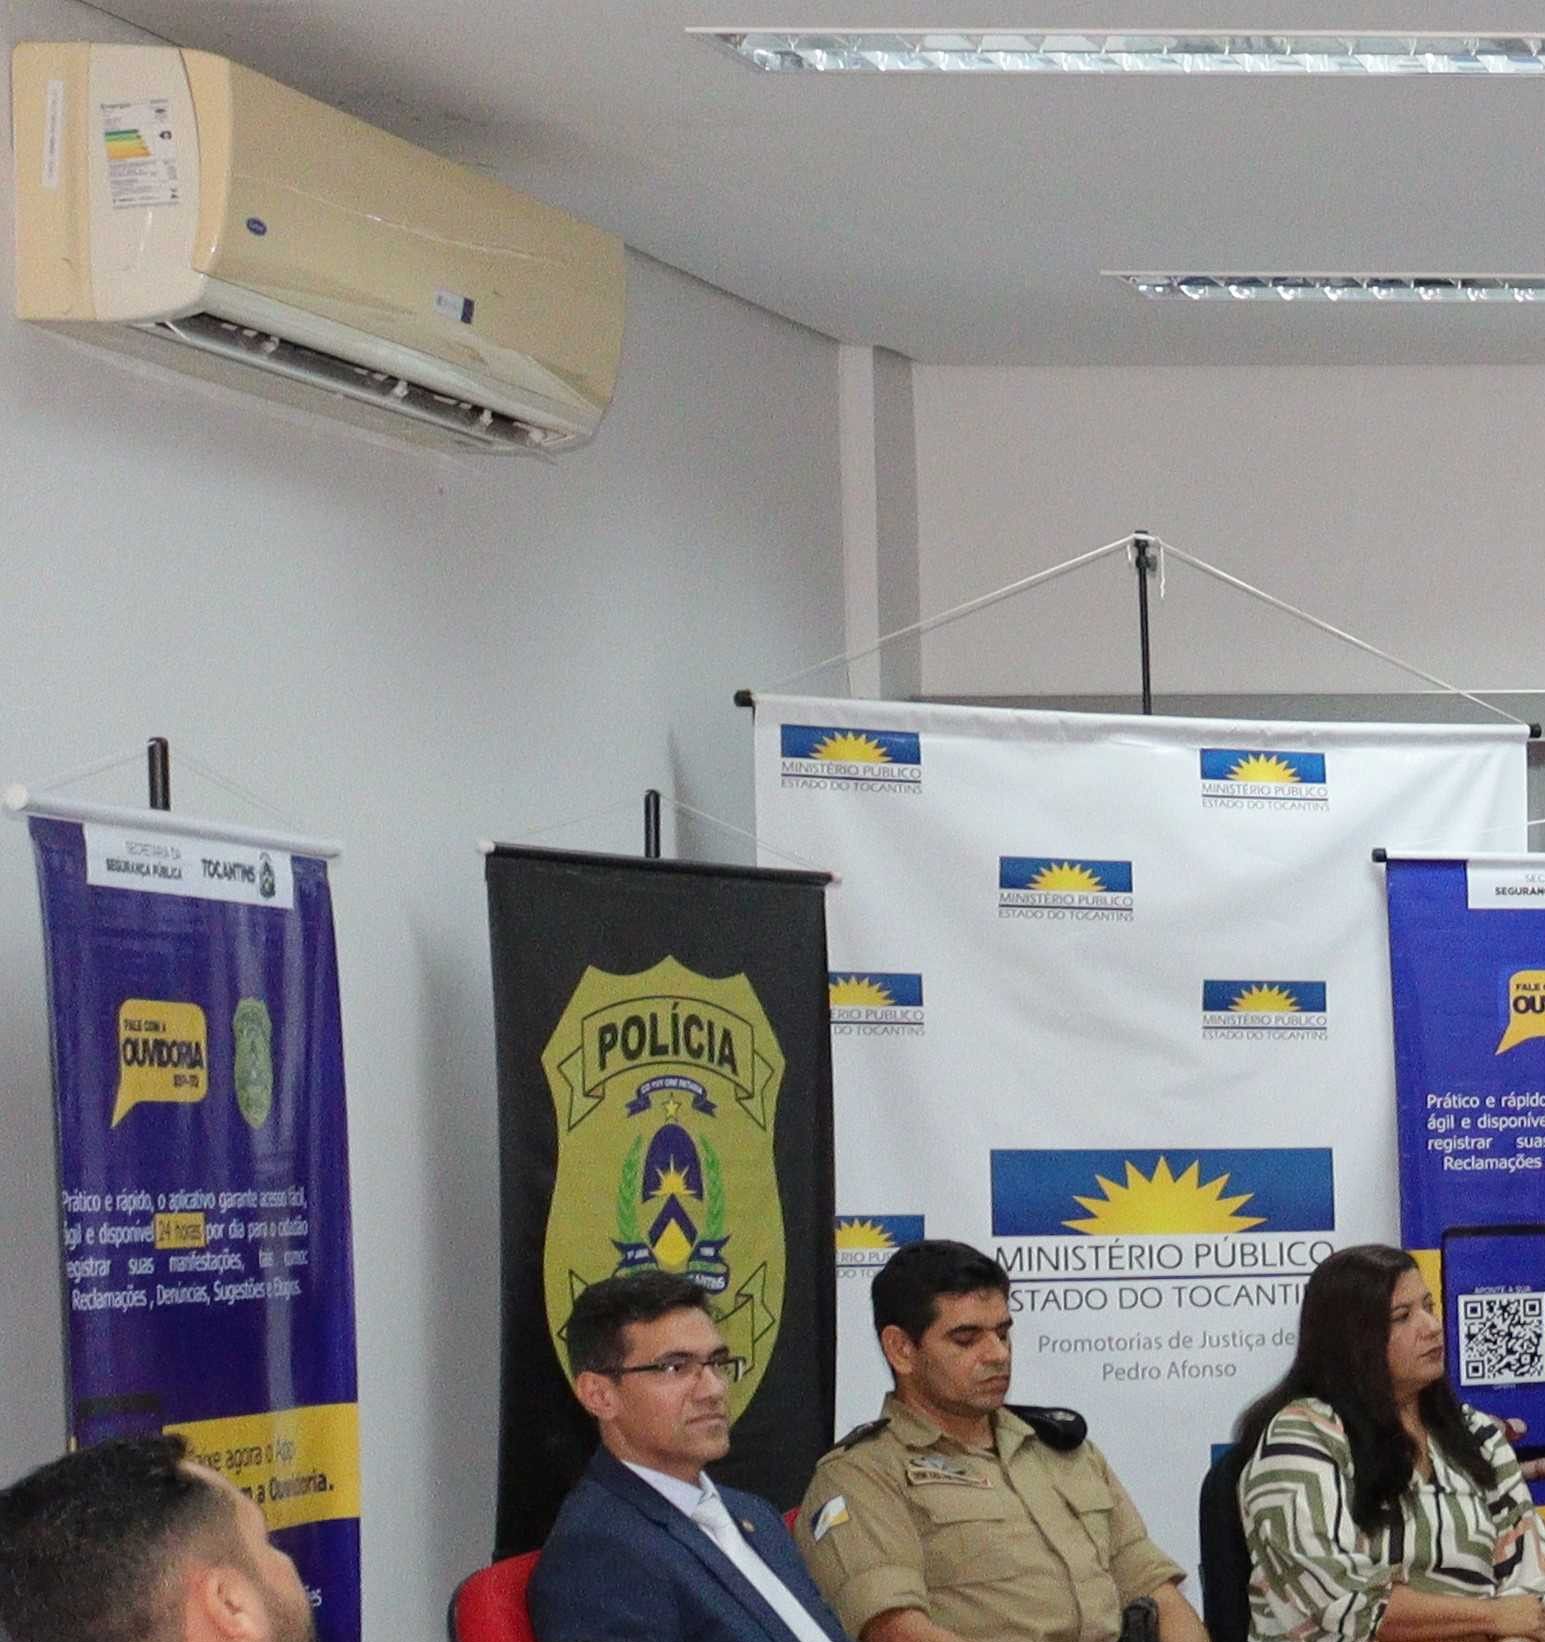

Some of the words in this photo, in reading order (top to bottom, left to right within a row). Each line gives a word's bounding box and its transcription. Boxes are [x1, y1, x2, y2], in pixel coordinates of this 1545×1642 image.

[781, 779, 828, 790] ESTADO
[830, 781, 850, 791] DO
[853, 782, 922, 795] TOCANTINS
[999, 909, 1045, 920] ESTADO
[1047, 910, 1066, 920] DO
[1516, 983, 1540, 991] FALE
[598, 1002, 739, 1077] POLÍCIA
[123, 1037, 204, 1069] OUVIDORIA
[1426, 1092, 1480, 1109] Prático
[1485, 1096, 1496, 1107] e
[1427, 1113, 1454, 1132] ágil
[1461, 1117, 1471, 1129] e
[1427, 1134, 1494, 1154] registrar
[1443, 1152, 1542, 1174] Reclamações
[104, 1193, 114, 1212] e
[157, 1192, 166, 1211] o
[85, 1226, 95, 1245] e
[207, 1222, 226, 1245] por
[996, 1239, 1183, 1273] MINISTÉRIO
[1194, 1236, 1334, 1269] PÚBLICO
[128, 1257, 154, 1275] suas
[1010, 1287, 1108, 1312] STADO
[1118, 1285, 1163, 1310] DO
[1172, 1281, 1307, 1308] TOCANTI
[1038, 1332, 1162, 1354] Promotorias
[1168, 1330, 1193, 1350] de
[1199, 1329, 1266, 1353] Justiça
[1271, 1327, 1295, 1347] de
[1102, 1361, 1161, 1382] Pedro
[1166, 1359, 1237, 1381] Afonso
